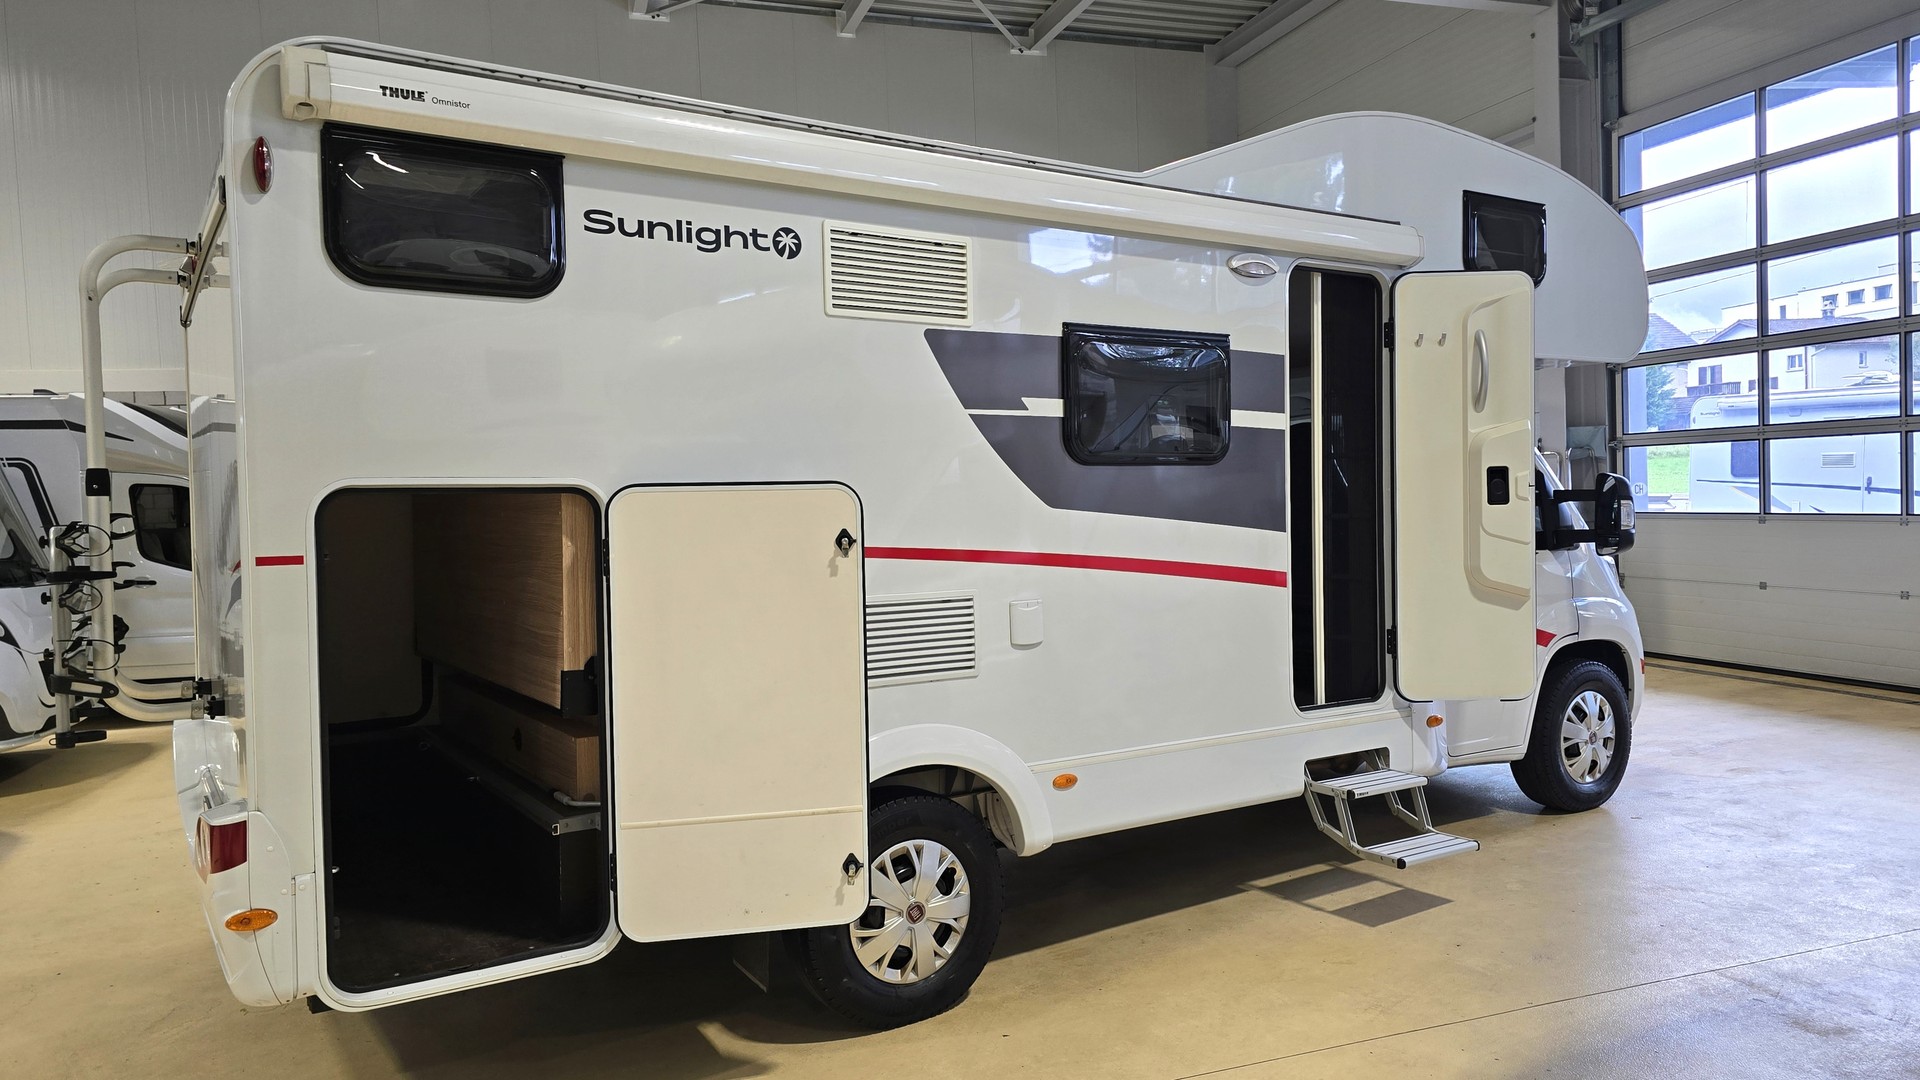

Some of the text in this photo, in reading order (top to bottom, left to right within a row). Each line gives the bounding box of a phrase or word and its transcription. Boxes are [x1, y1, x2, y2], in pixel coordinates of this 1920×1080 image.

[379, 85, 470, 109] THULE Omnistor
[583, 209, 771, 253] Sunlight
